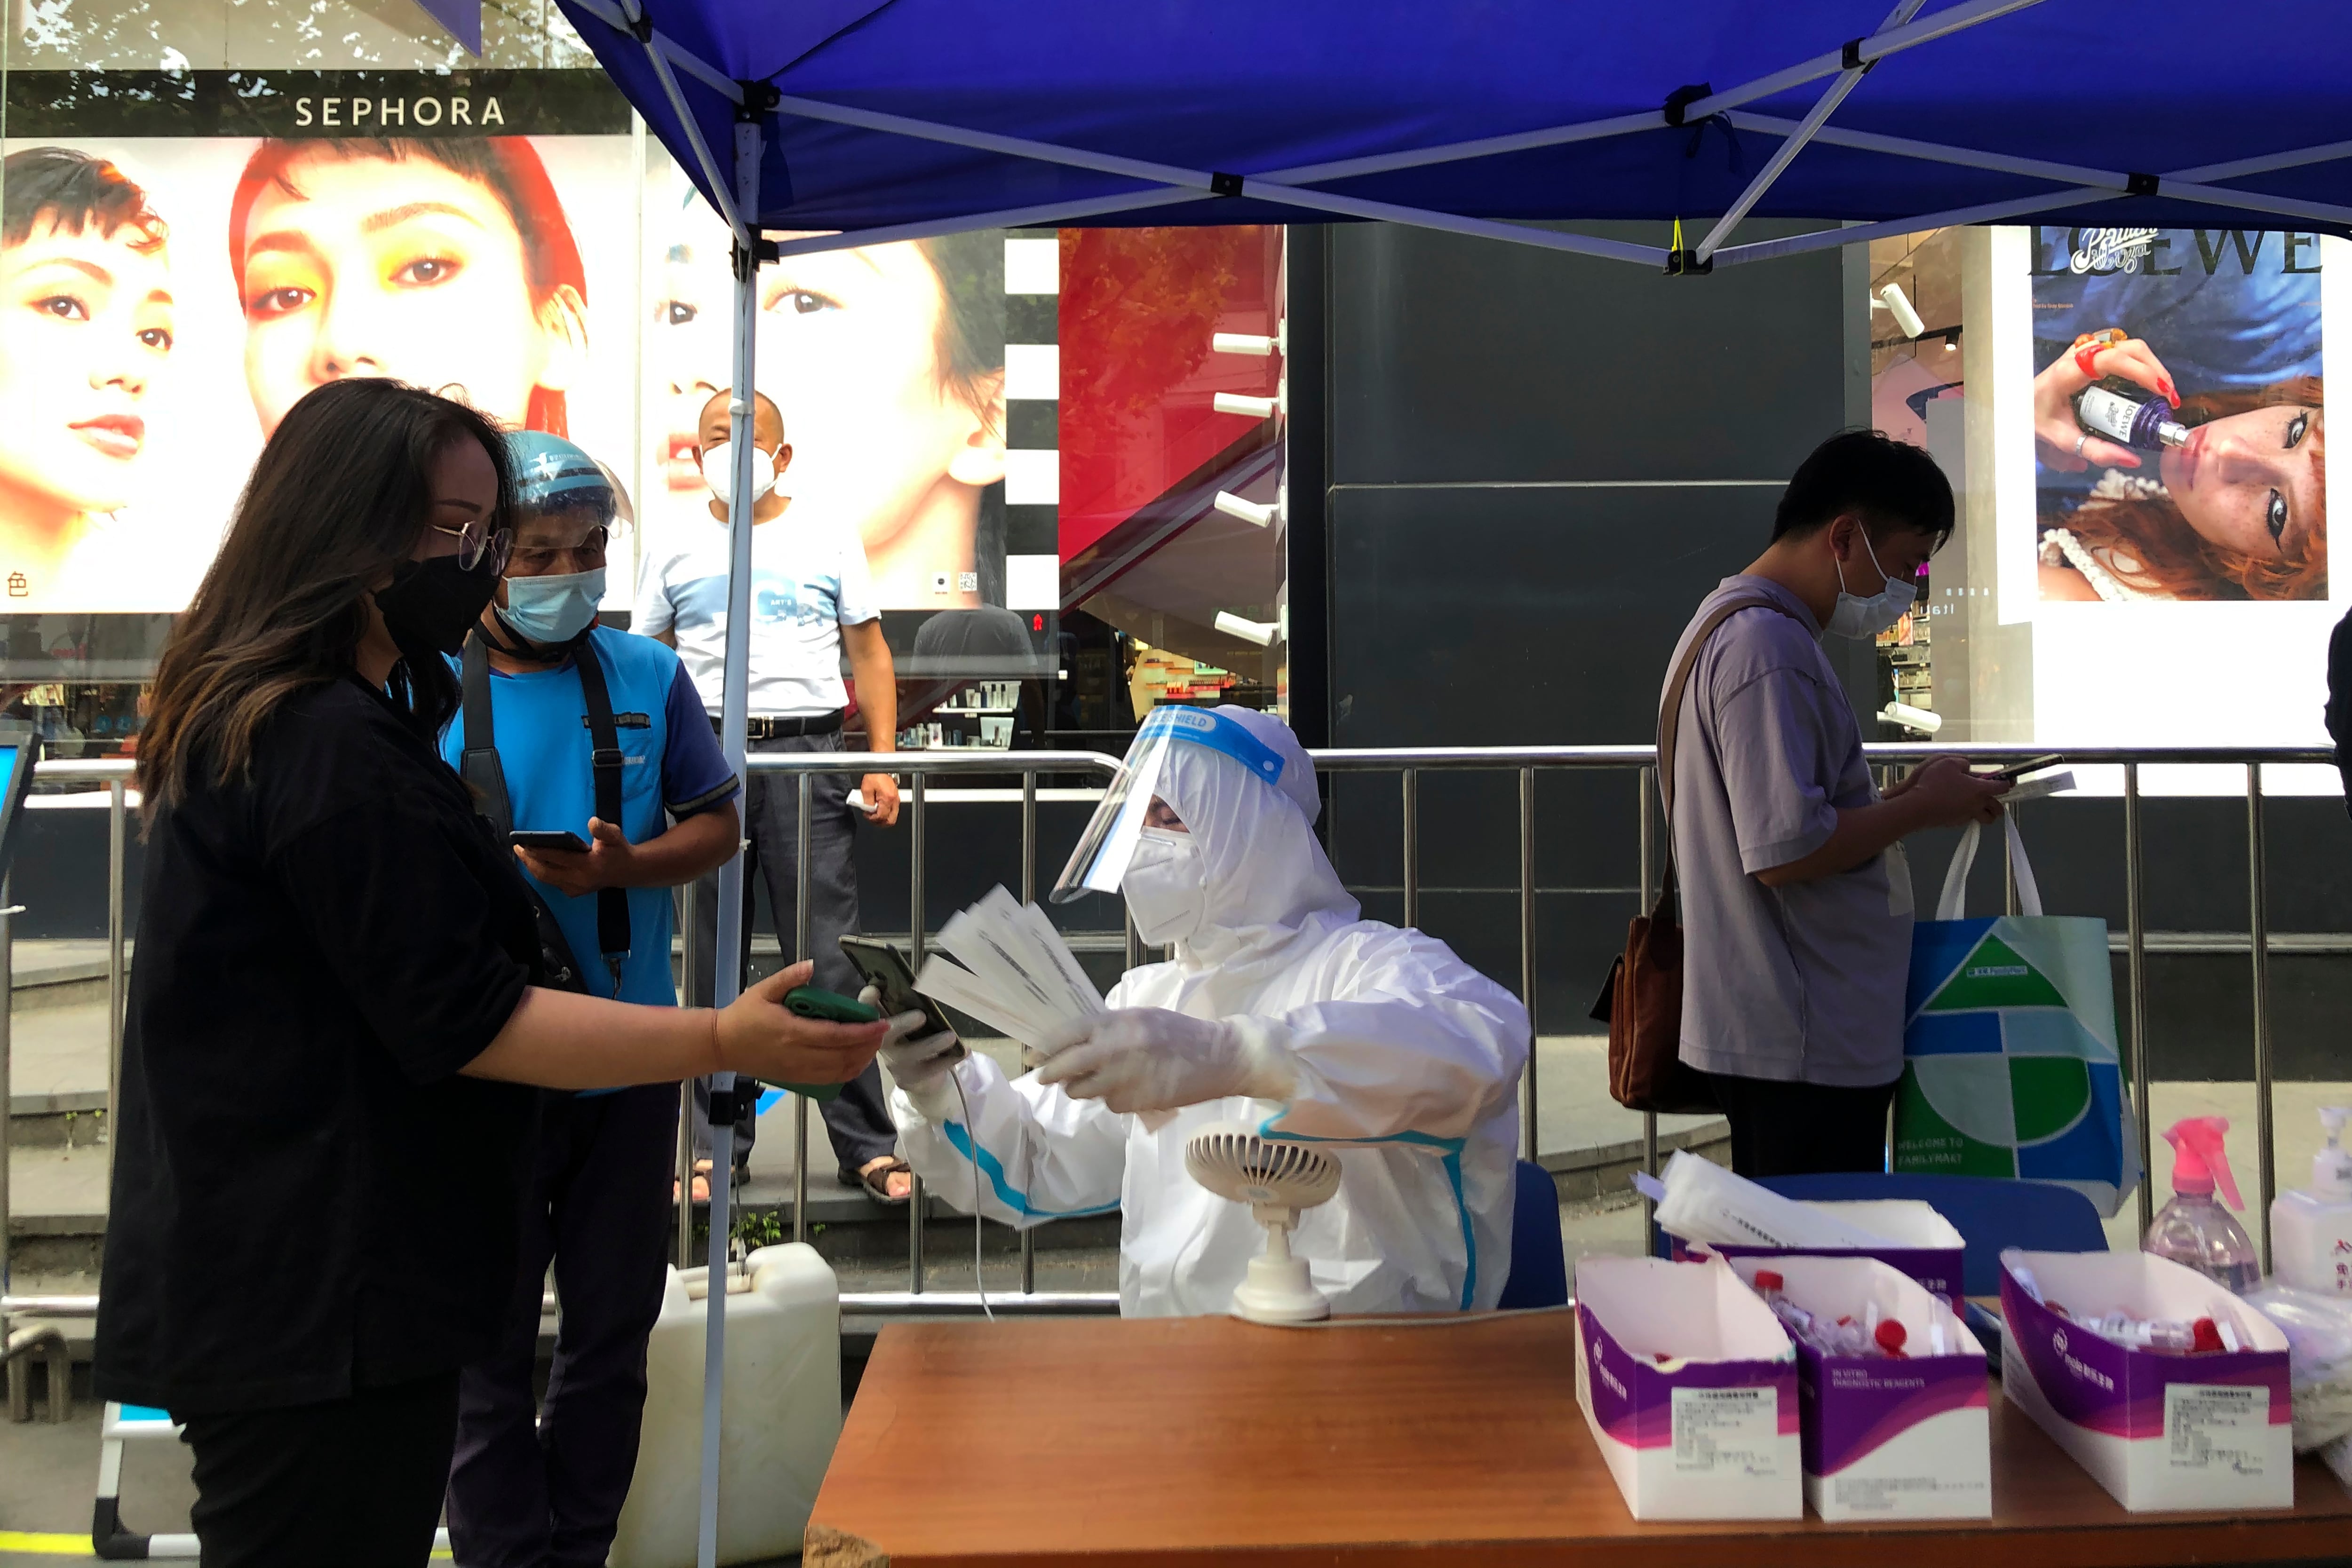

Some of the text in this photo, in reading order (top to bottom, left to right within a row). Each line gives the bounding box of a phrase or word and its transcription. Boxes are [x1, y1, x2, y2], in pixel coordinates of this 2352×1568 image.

[295, 96, 505, 127] SEPHORA
[2119, 404, 2137, 438] LOEWE
[7, 571, 28, 597] 色
[1949, 1137, 1963, 1148] TO
